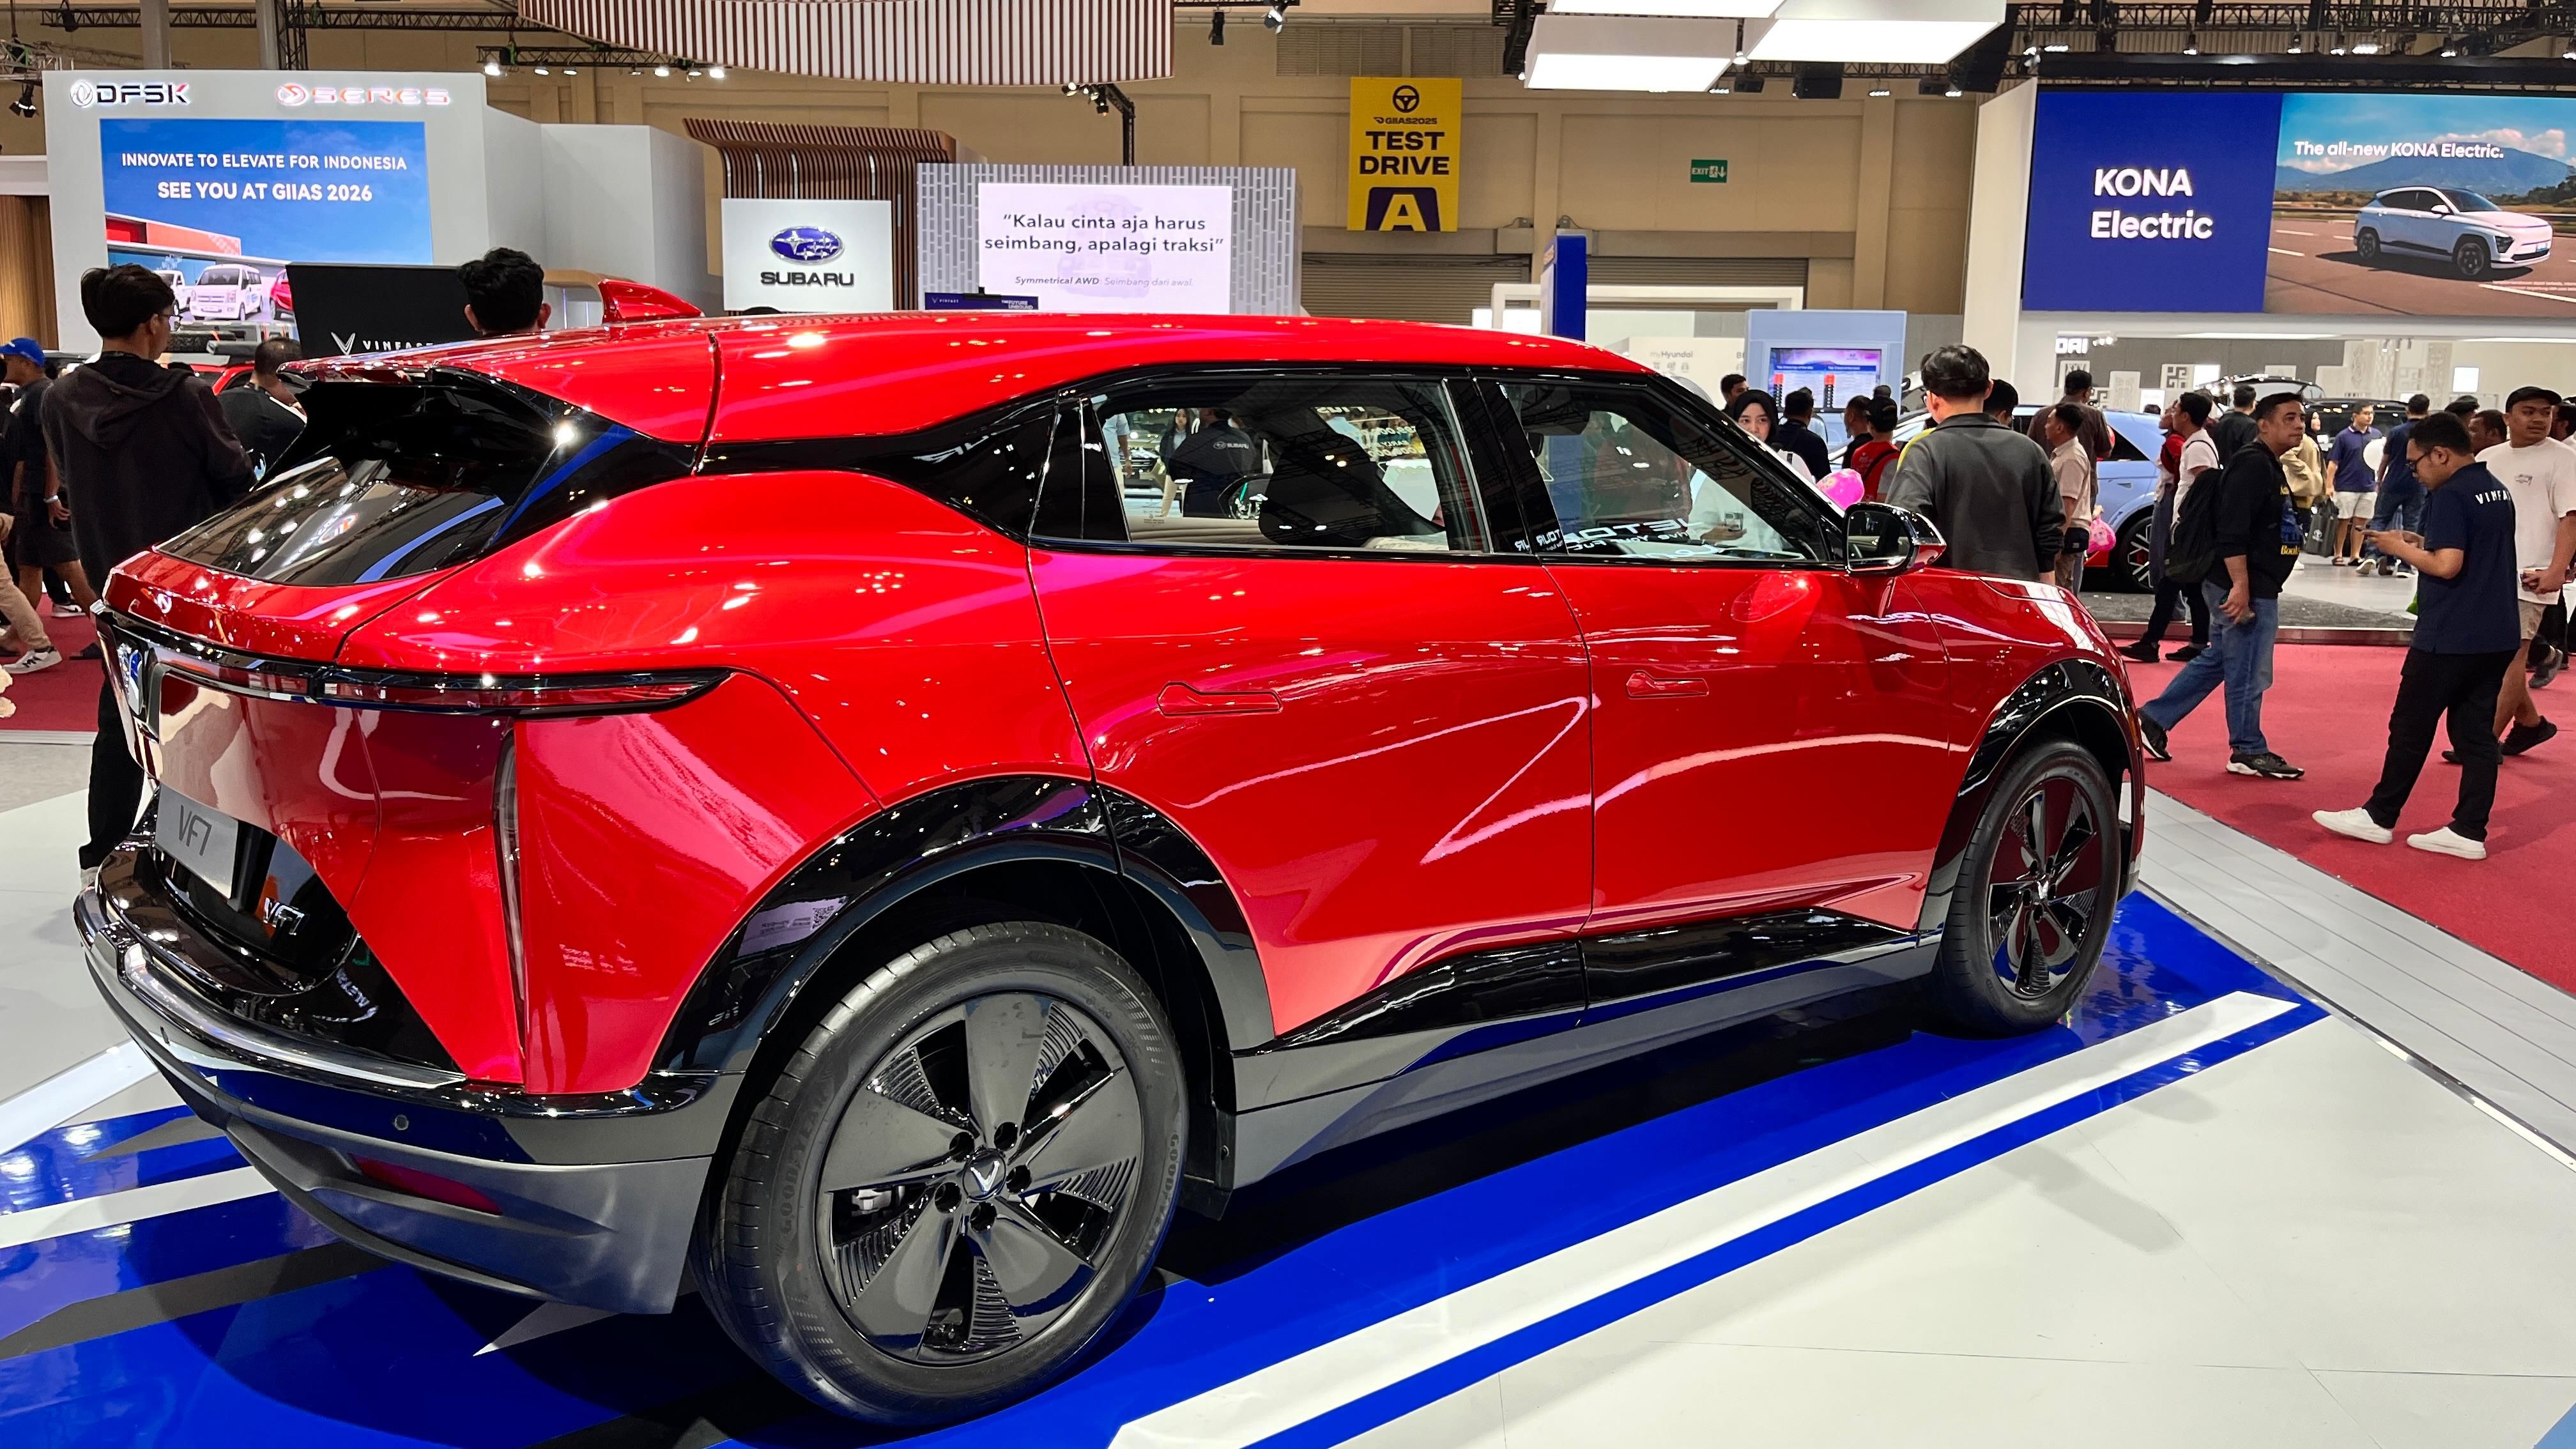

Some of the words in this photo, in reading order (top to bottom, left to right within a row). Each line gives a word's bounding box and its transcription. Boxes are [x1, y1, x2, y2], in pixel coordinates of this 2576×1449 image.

[96, 83, 190, 104] DFSK
[312, 86, 450, 105] SERES
[1365, 131, 1445, 150] TEST
[2294, 141, 2324, 157] The
[2327, 141, 2388, 157] all-new
[2391, 142, 2438, 157] KONA
[2441, 142, 2504, 159] Electric.
[121, 153, 194, 167] INNOVATE
[197, 153, 218, 167] TO
[223, 154, 284, 168] ELEVATE
[289, 155, 319, 169] FOR
[324, 155, 407, 170] INDONESIA
[1360, 155, 1450, 175] DRIVE
[158, 181, 192, 199] SEE
[195, 182, 238, 200] YOU
[242, 183, 268, 200] AT
[272, 183, 323, 201] GIIAS
[326, 184, 372, 202] 2026
[2094, 168, 2193, 197] KONA
[1379, 194, 1427, 232] A
[1071, 215, 1116, 229] cinta
[1122, 216, 1148, 233] aja
[1155, 215, 1206, 230] harus
[2090, 210, 2213, 240] Electric
[985, 234, 1082, 254] seimbang,
[1088, 236, 1156, 255] apalagi
[760, 271, 855, 287] SUBARU
[1015, 276, 1073, 286] Symmetrical
[179, 804, 212, 856] VF7
[263, 897, 309, 936] VF7
